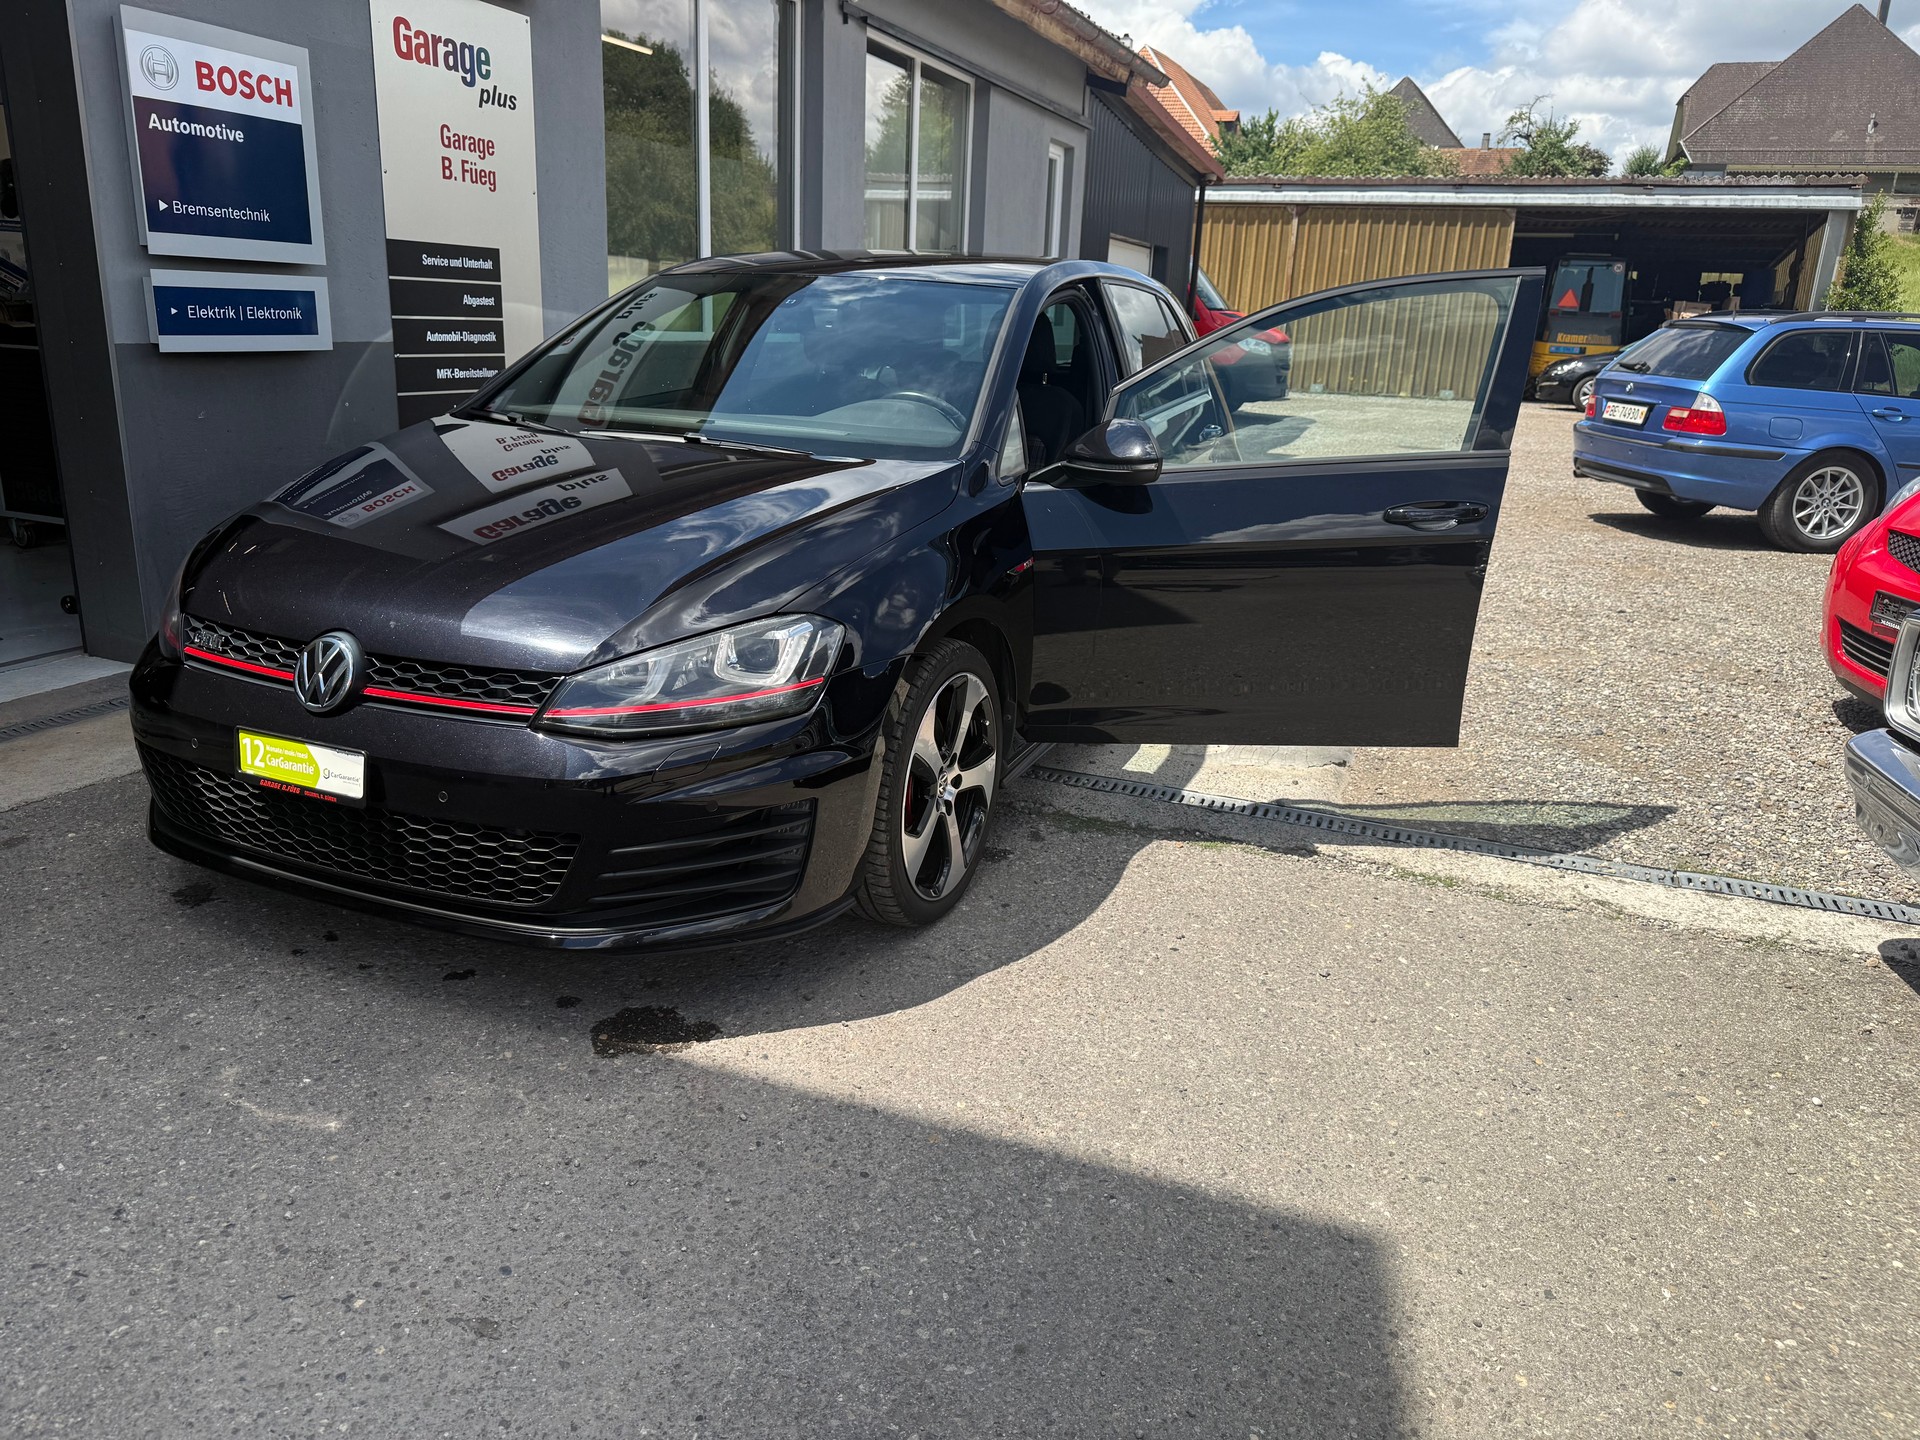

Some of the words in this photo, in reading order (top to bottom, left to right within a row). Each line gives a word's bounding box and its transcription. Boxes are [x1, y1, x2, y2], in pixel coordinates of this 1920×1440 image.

[392, 16, 492, 88] Garage
[195, 60, 293, 108] BOSCH
[478, 85, 517, 110] plus
[148, 113, 244, 143] Automotive
[440, 124, 496, 160] Garage
[441, 156, 458, 181] B.
[461, 159, 496, 192] Füeg
[172, 200, 270, 222] Bremsentechnik
[422, 254, 448, 267] Service
[450, 257, 462, 268] und
[463, 257, 494, 270] Unterhalt
[187, 305, 236, 319] Elektrik
[246, 306, 302, 320] Elektronik
[462, 294, 495, 308] Abgastest
[426, 331, 497, 344] Automobil-Diagnostik
[242, 737, 265, 768] 12
